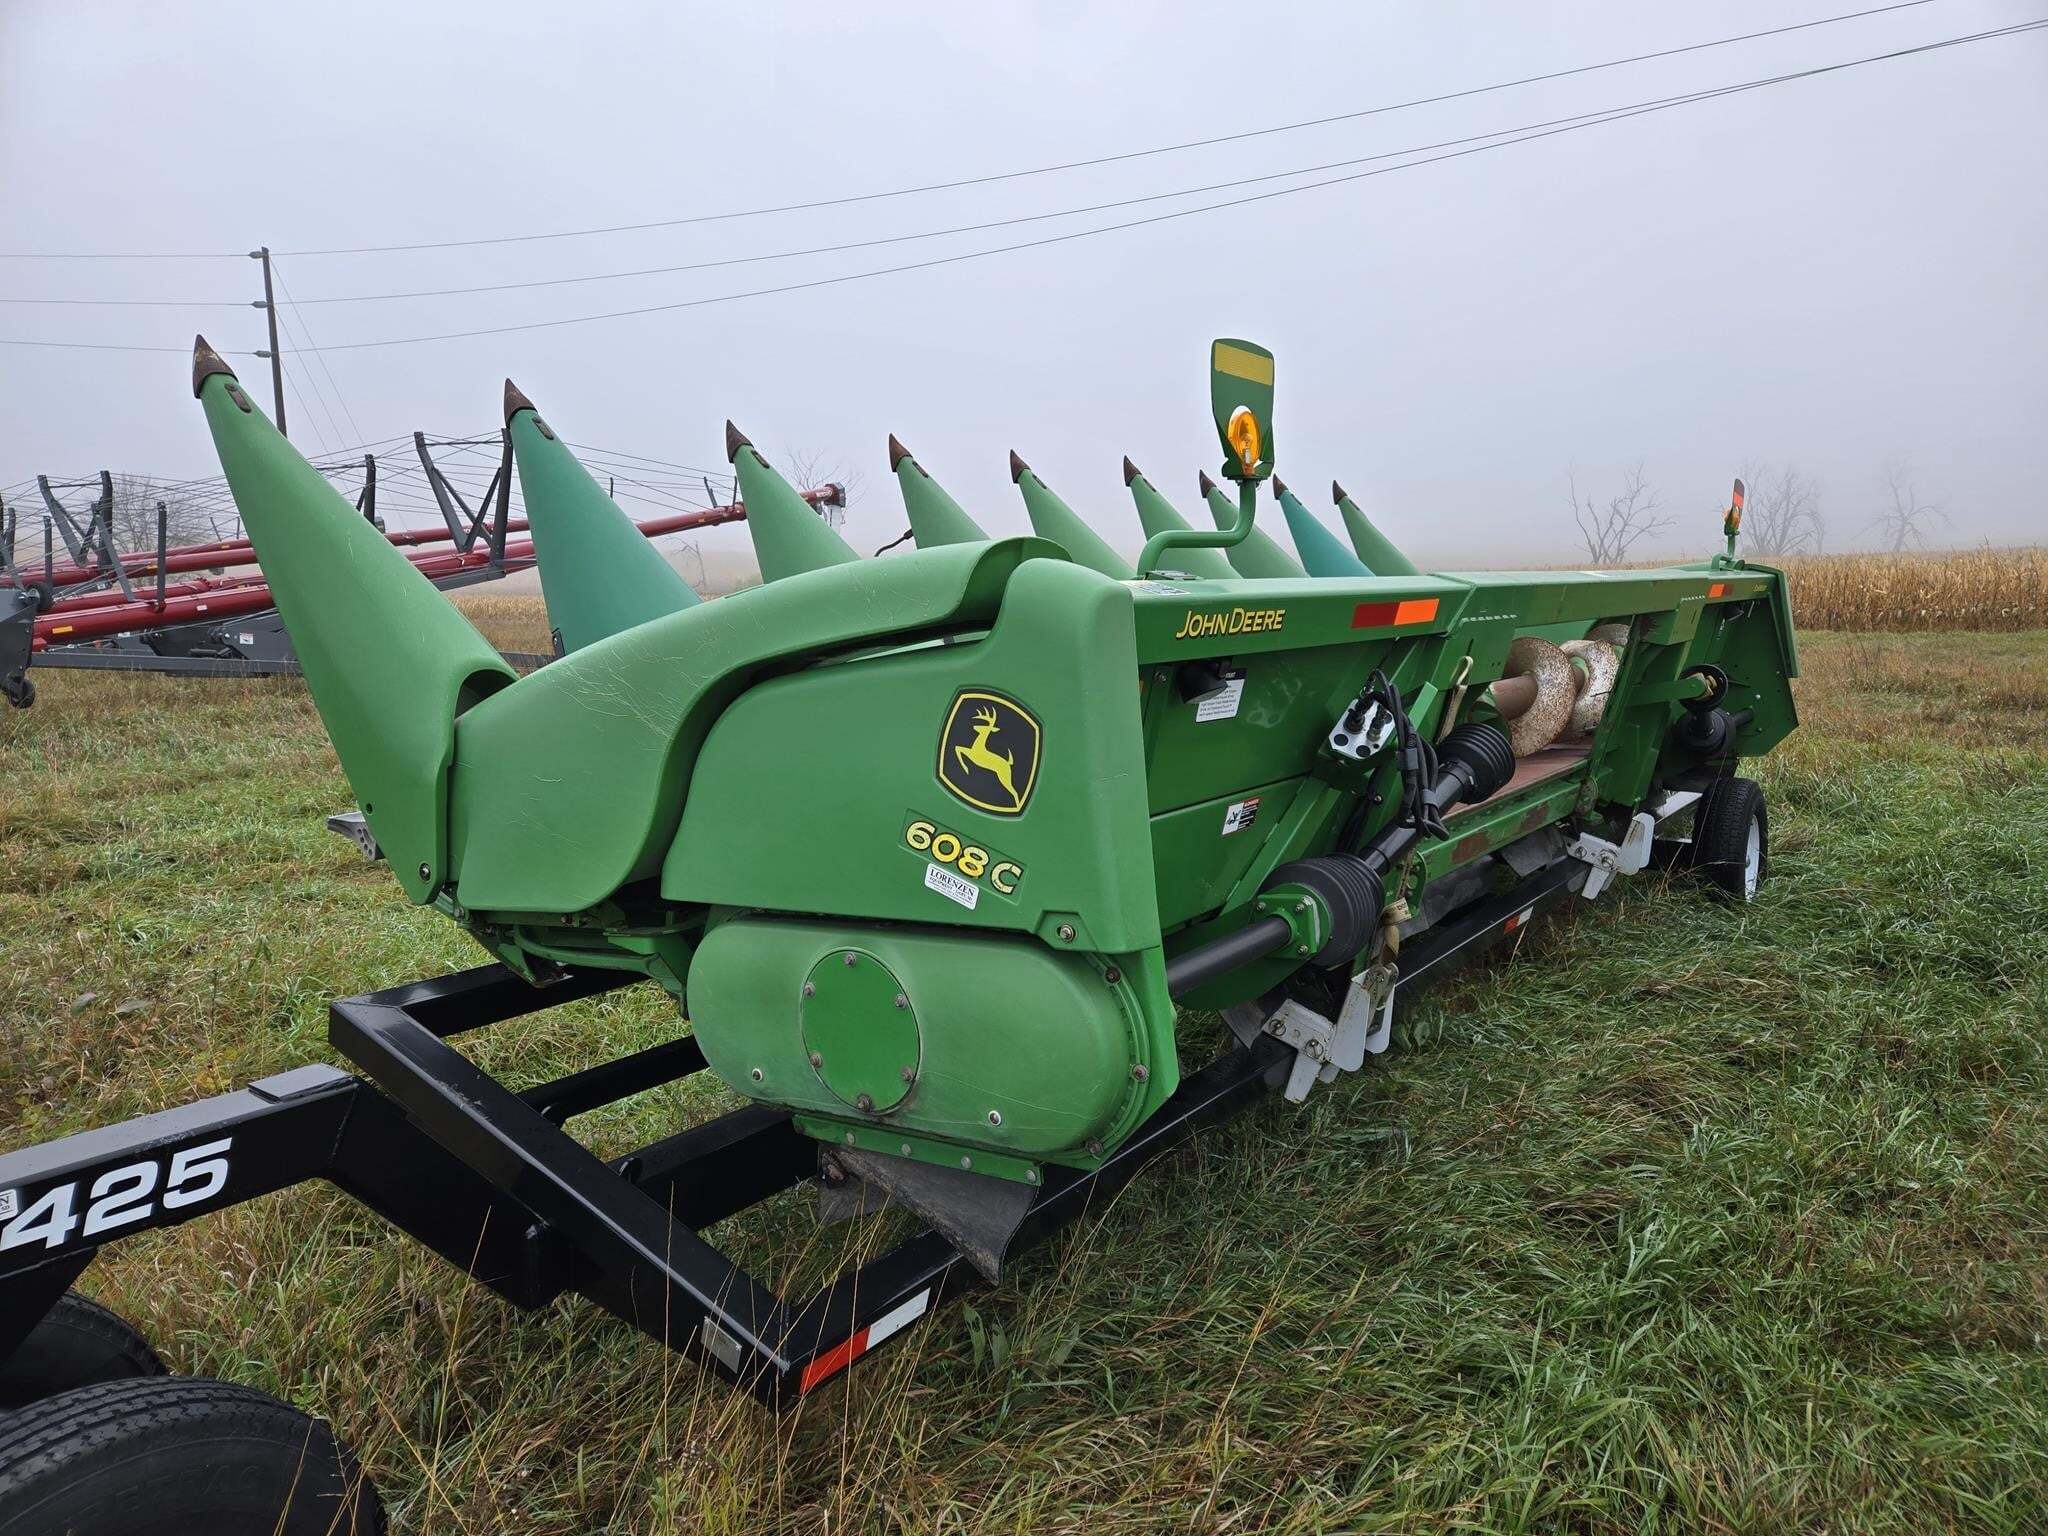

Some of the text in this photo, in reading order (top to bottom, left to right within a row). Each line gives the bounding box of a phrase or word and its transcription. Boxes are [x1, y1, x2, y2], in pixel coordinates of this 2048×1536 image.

[1175, 607, 1286, 639] JOHN DEERE
[930, 868, 975, 897] LORENZEN
[0, 1137, 233, 1250] 425
